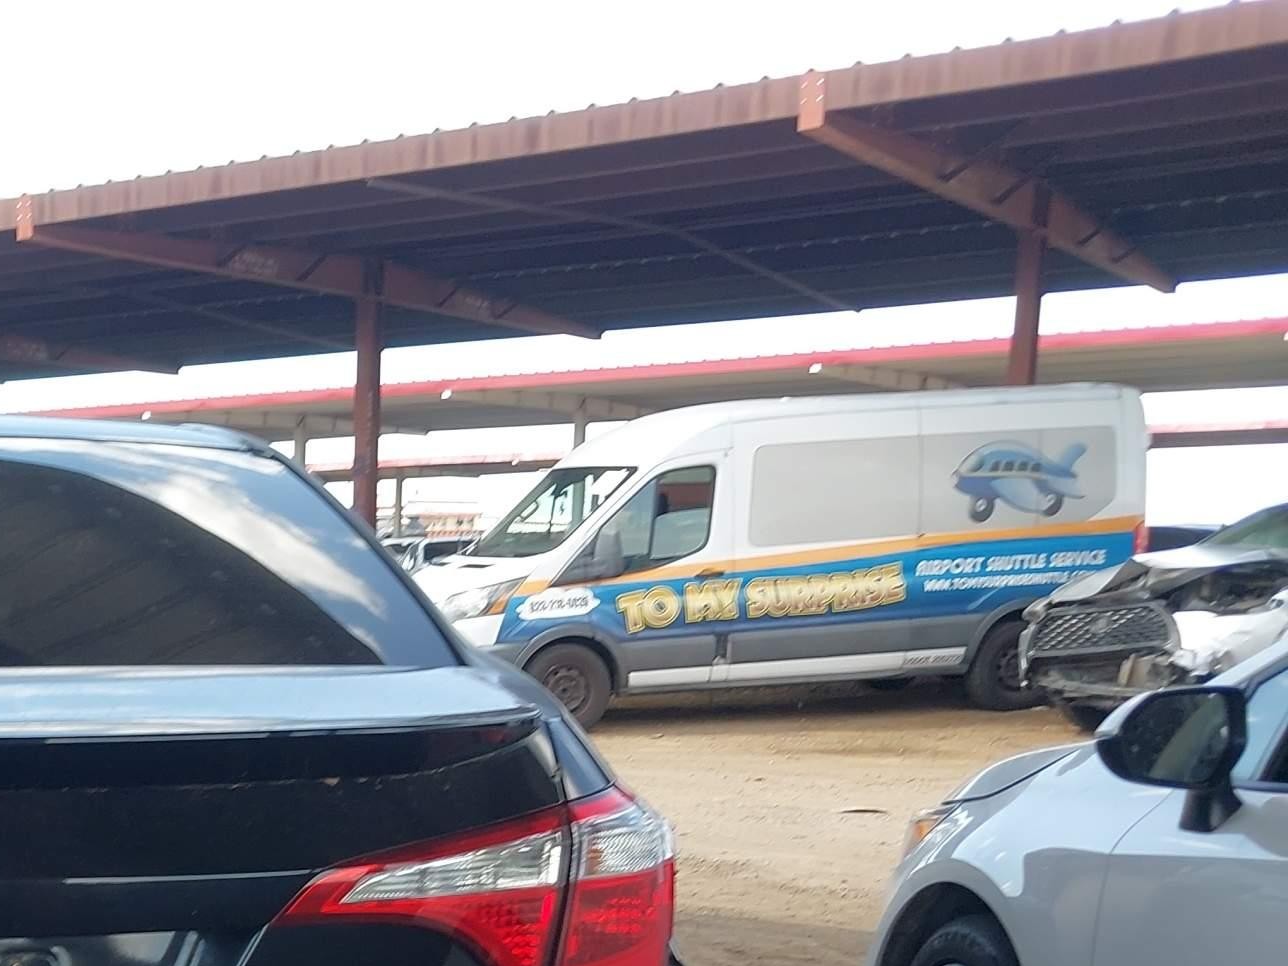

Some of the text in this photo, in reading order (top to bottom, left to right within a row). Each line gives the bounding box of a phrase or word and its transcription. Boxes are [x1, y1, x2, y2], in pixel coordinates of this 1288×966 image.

[915, 549, 1107, 576] AIRPORT SHUTTLE SERVICE
[616, 560, 908, 635] TO MY SURPRISE
